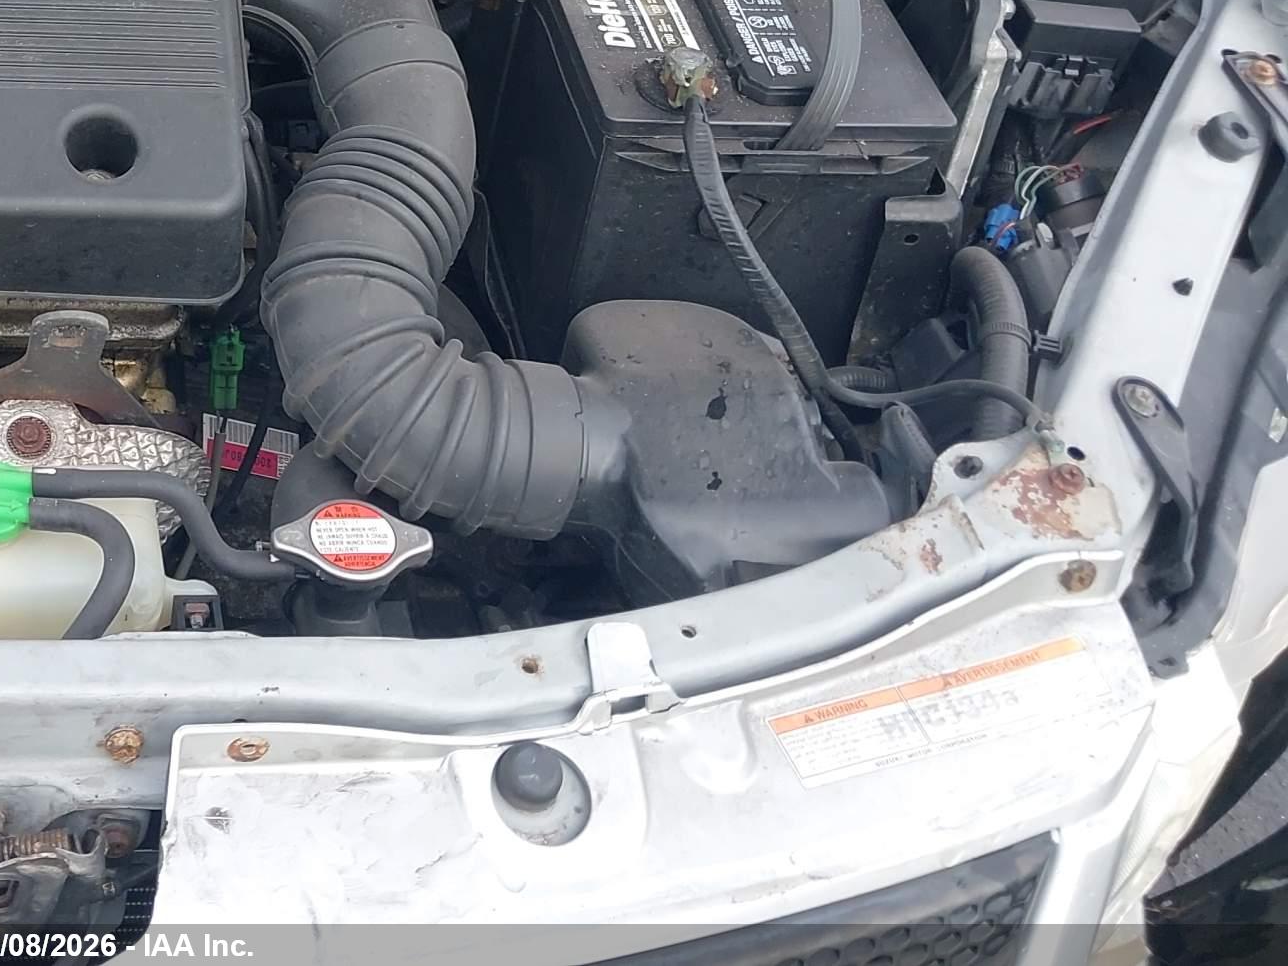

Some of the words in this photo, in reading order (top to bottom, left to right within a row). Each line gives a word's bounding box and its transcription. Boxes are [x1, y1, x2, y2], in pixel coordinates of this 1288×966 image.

[736, 23, 760, 55] DANGER
[815, 699, 868, 720] WARNING
[952, 651, 1041, 687] AVERTISSEMENT
